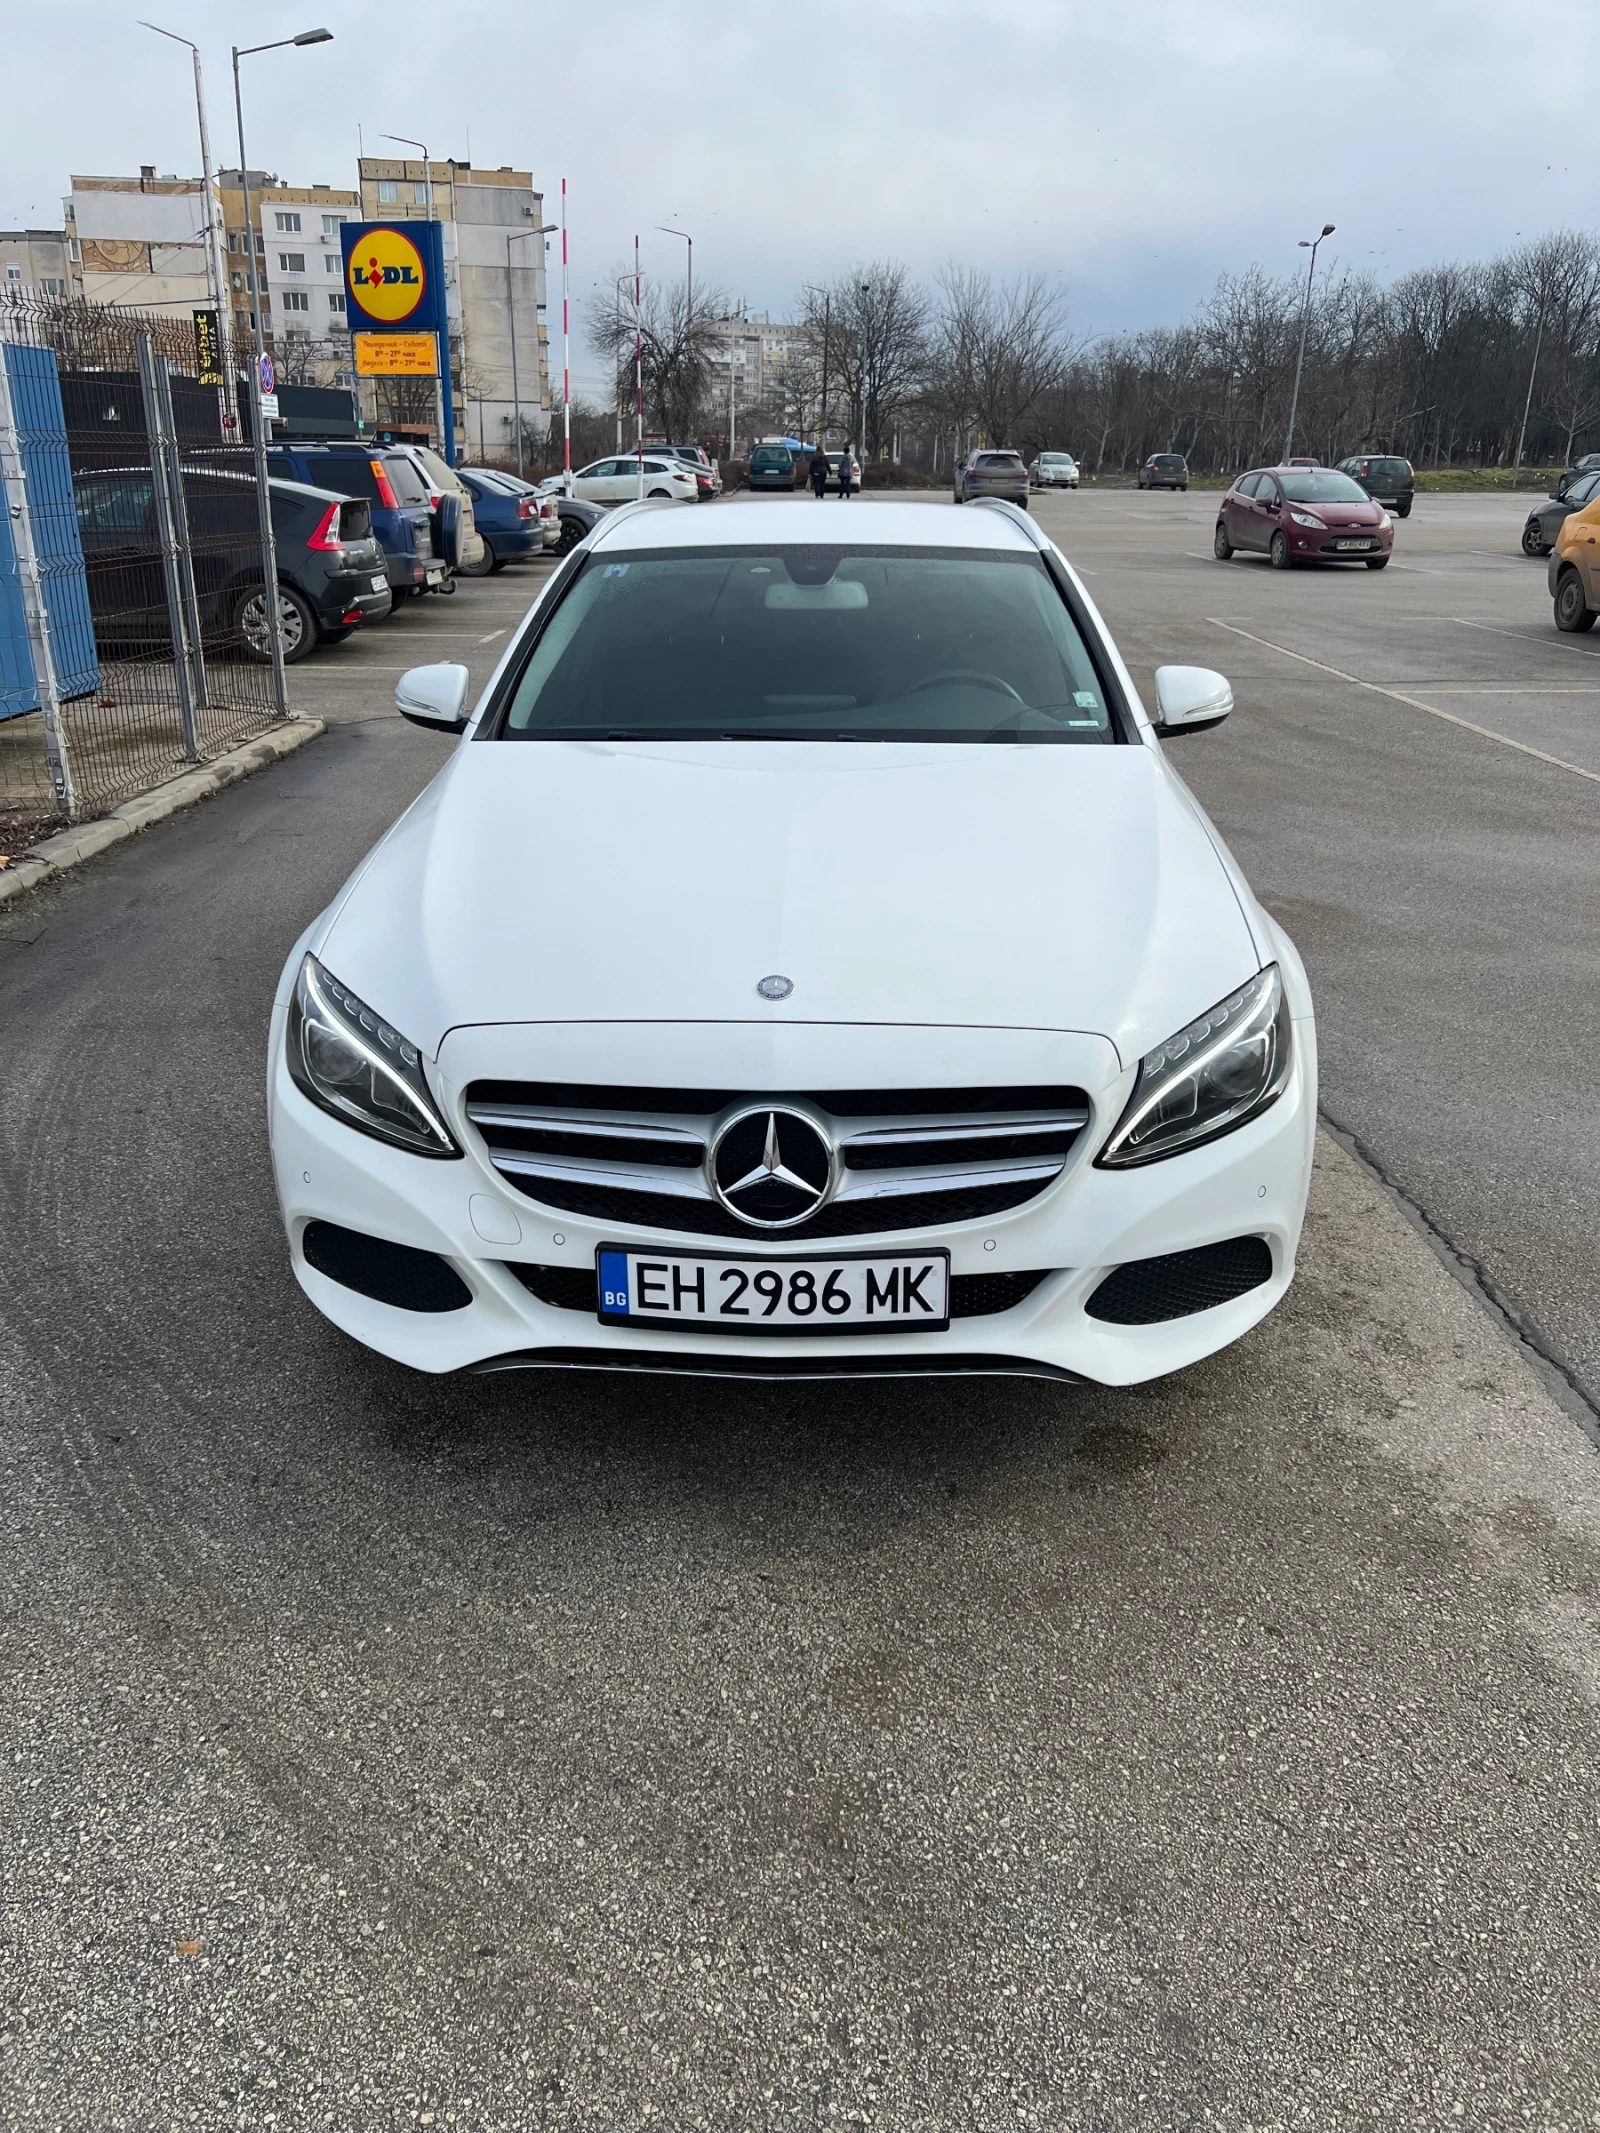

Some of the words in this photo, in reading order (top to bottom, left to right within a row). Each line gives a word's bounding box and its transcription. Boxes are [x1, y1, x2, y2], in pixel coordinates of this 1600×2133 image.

[605, 1291, 626, 1306] BG
[636, 1262, 705, 1313] EH
[719, 1268, 852, 1316] 2986
[866, 1265, 935, 1315] MK
